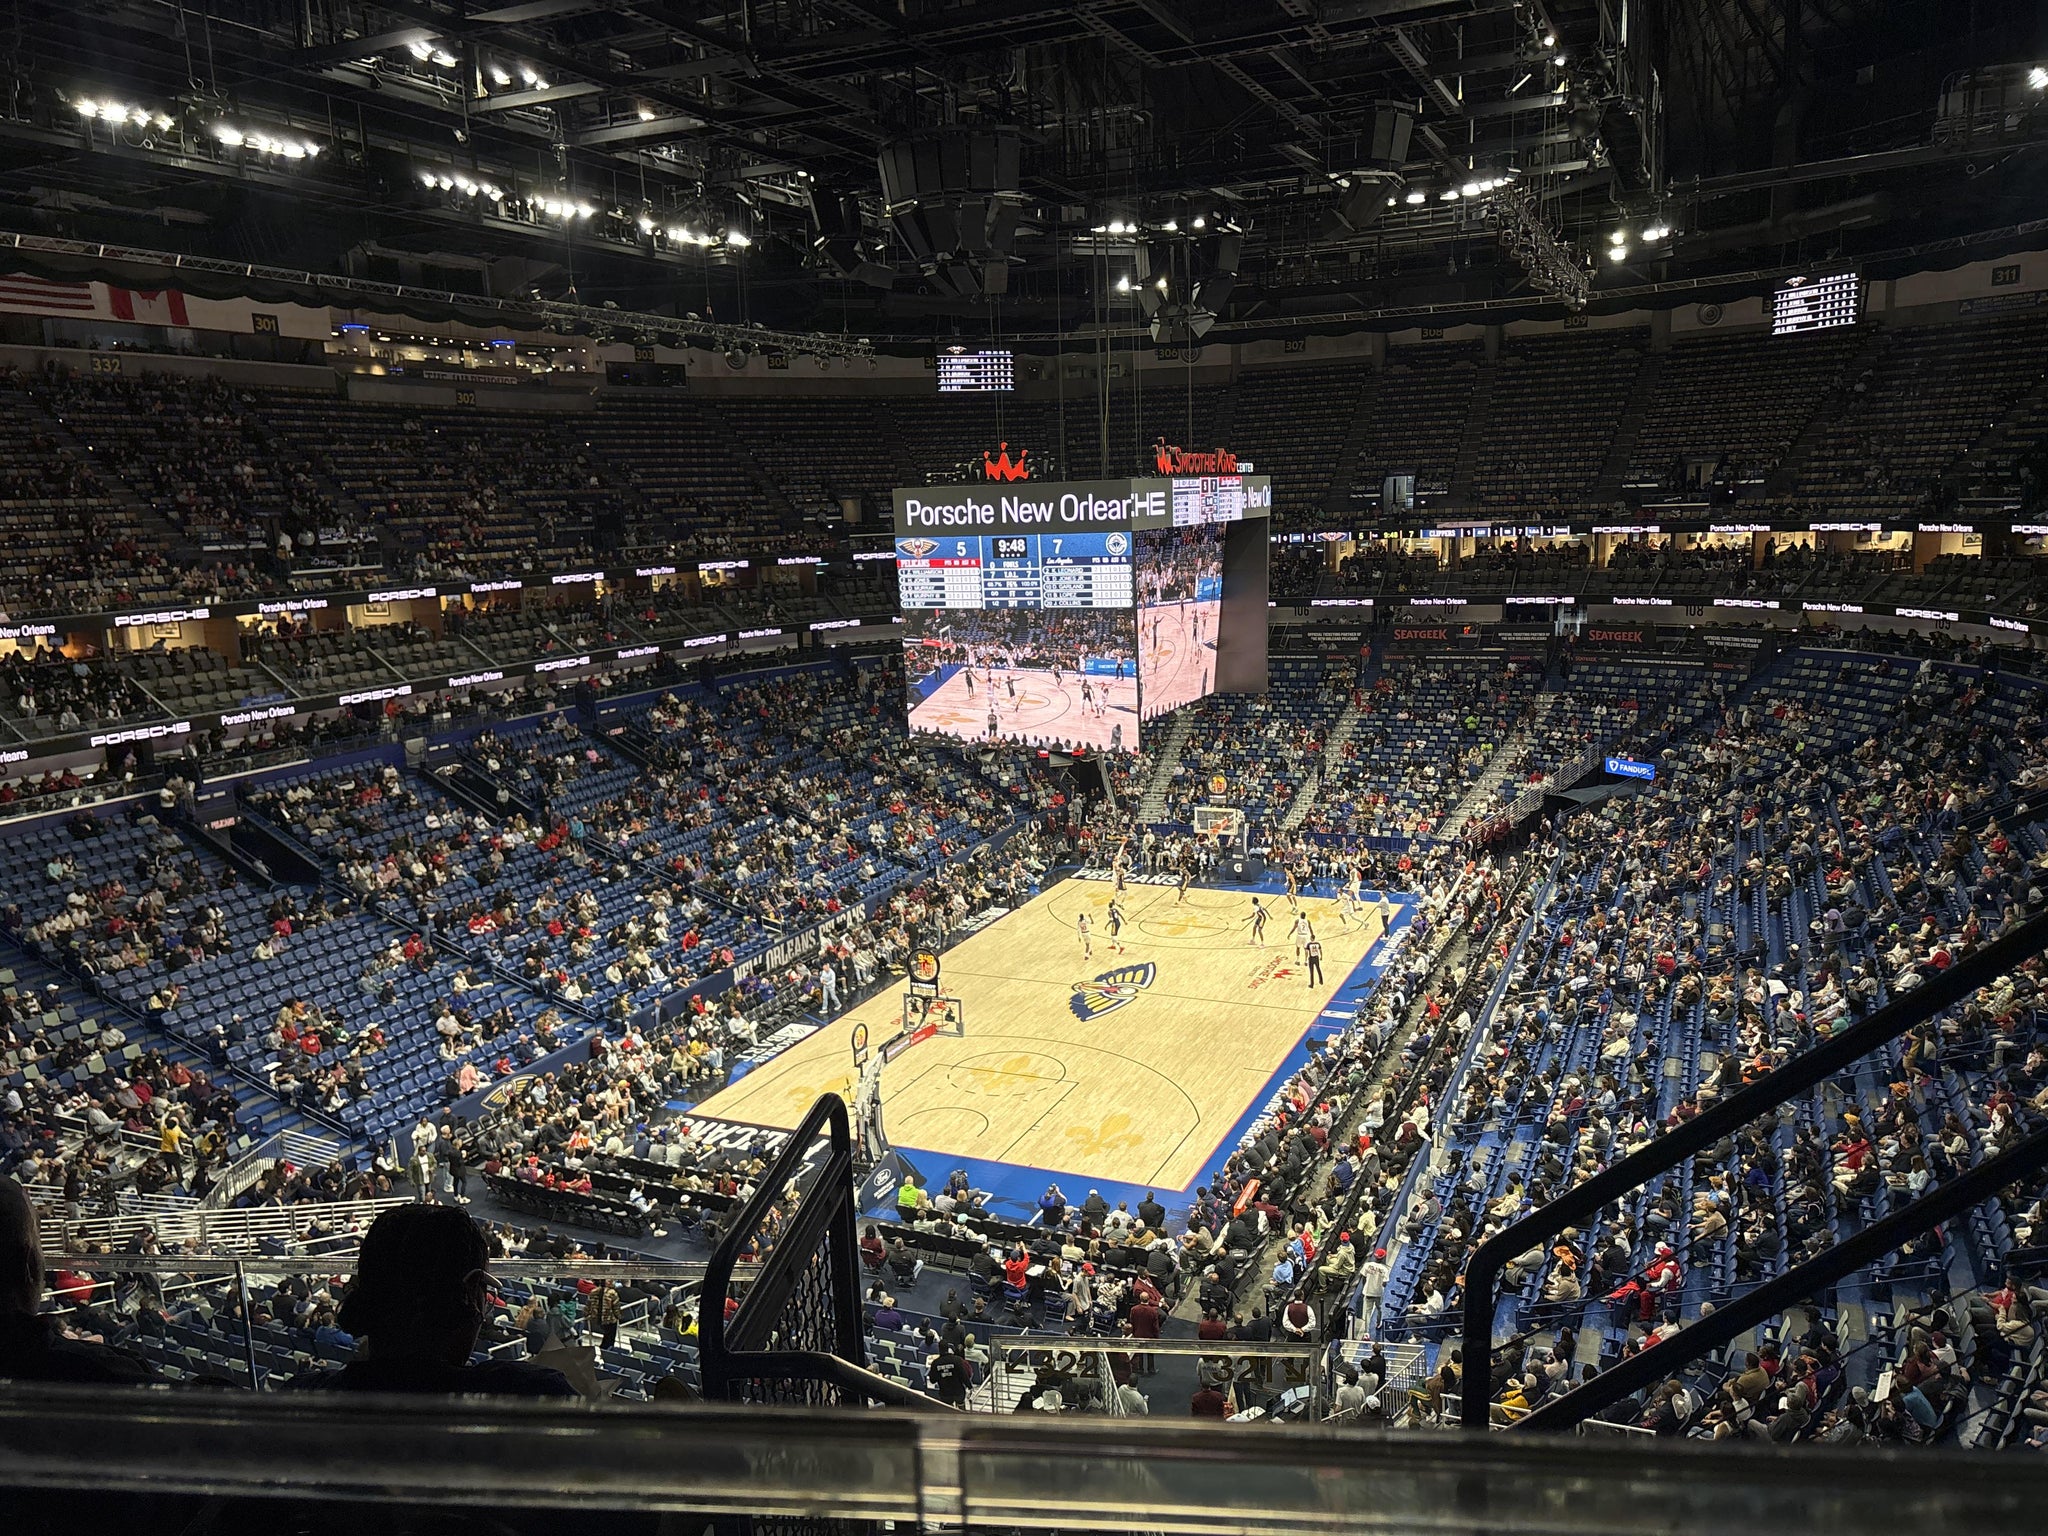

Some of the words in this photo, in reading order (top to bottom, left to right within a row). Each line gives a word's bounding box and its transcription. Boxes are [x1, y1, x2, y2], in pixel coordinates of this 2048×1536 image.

[1995, 268, 2018, 283] 311
[255, 316, 277, 333] 301
[92, 357, 121, 374] 332
[457, 391, 475, 405] 302
[905, 498, 994, 526] Porsche
[1001, 496, 1054, 524] New
[1592, 526, 1659, 535] PORSCHE
[1710, 525, 1734, 533] Porsche
[1734, 525, 1749, 533] New
[1749, 524, 1770, 533] Orleans
[1810, 524, 1882, 534] PORSCHE
[956, 542, 967, 556] 5
[998, 539, 1025, 552] 9:48
[1052, 539, 1063, 554] 7
[699, 561, 748, 571] PORSCHE
[552, 572, 604, 584] PORSCHE
[369, 588, 436, 604] PORSCHE
[259, 602, 286, 615] Porsche
[286, 601, 302, 613] New
[303, 599, 327, 609] Orleans
[1714, 599, 1779, 608] PORSCHE
[1803, 602, 1826, 610] Porsche
[1842, 604, 1862, 612] Orleans
[1685, 605, 1703, 617] 108
[1896, 608, 1958, 621] PORSCHE
[115, 609, 209, 628] PORSCHE
[810, 620, 860, 630] PORSCHE
[21, 624, 56, 640] Orleans
[1394, 629, 1448, 641] SEATGEEK
[1588, 629, 1643, 643] SEATGEEK
[684, 635, 726, 647] PORSCHE
[535, 656, 589, 672] PORSCHE
[339, 686, 411, 705] PORSCHE
[222, 713, 250, 725] Porsche
[251, 711, 268, 720] New
[269, 707, 295, 717] Orleans
[91, 724, 190, 747] PORSCHE
[1233, 862, 1243, 873] G
[766, 929, 816, 972] ORLEANS
[1035, 1350, 1101, 1379] 322
[1212, 1354, 1274, 1384] 321
